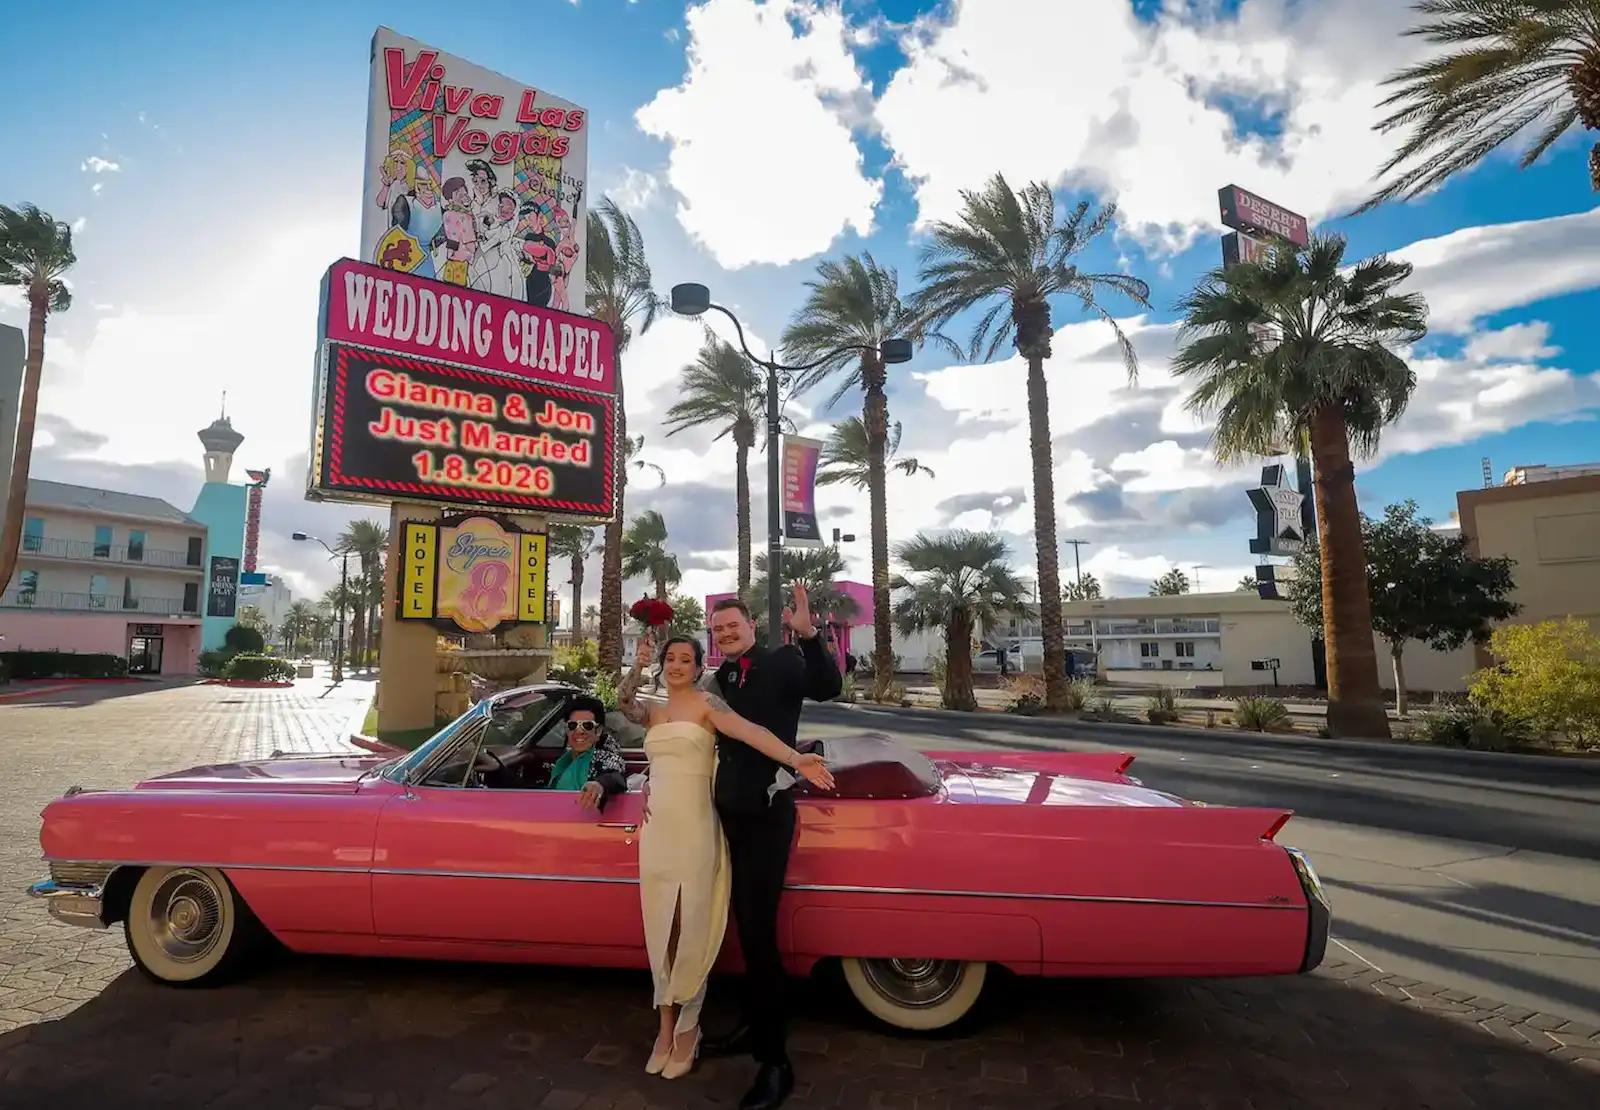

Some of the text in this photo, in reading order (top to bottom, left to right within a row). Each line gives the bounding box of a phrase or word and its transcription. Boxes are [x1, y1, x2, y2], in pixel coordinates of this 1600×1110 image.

[384, 47, 585, 132] Viva Las
[431, 113, 571, 165] Vegas
[1239, 192, 1300, 230] DESERT
[1251, 213, 1291, 239] STAR
[344, 271, 604, 382] WEDDING CHAPEL
[366, 369, 593, 432] Gianna & Jon
[369, 408, 590, 465] Just Married
[412, 451, 551, 491] 1.8.2026
[413, 532, 427, 610] HOTEL
[459, 560, 512, 620] 8
[527, 541, 537, 614] HOTEL
